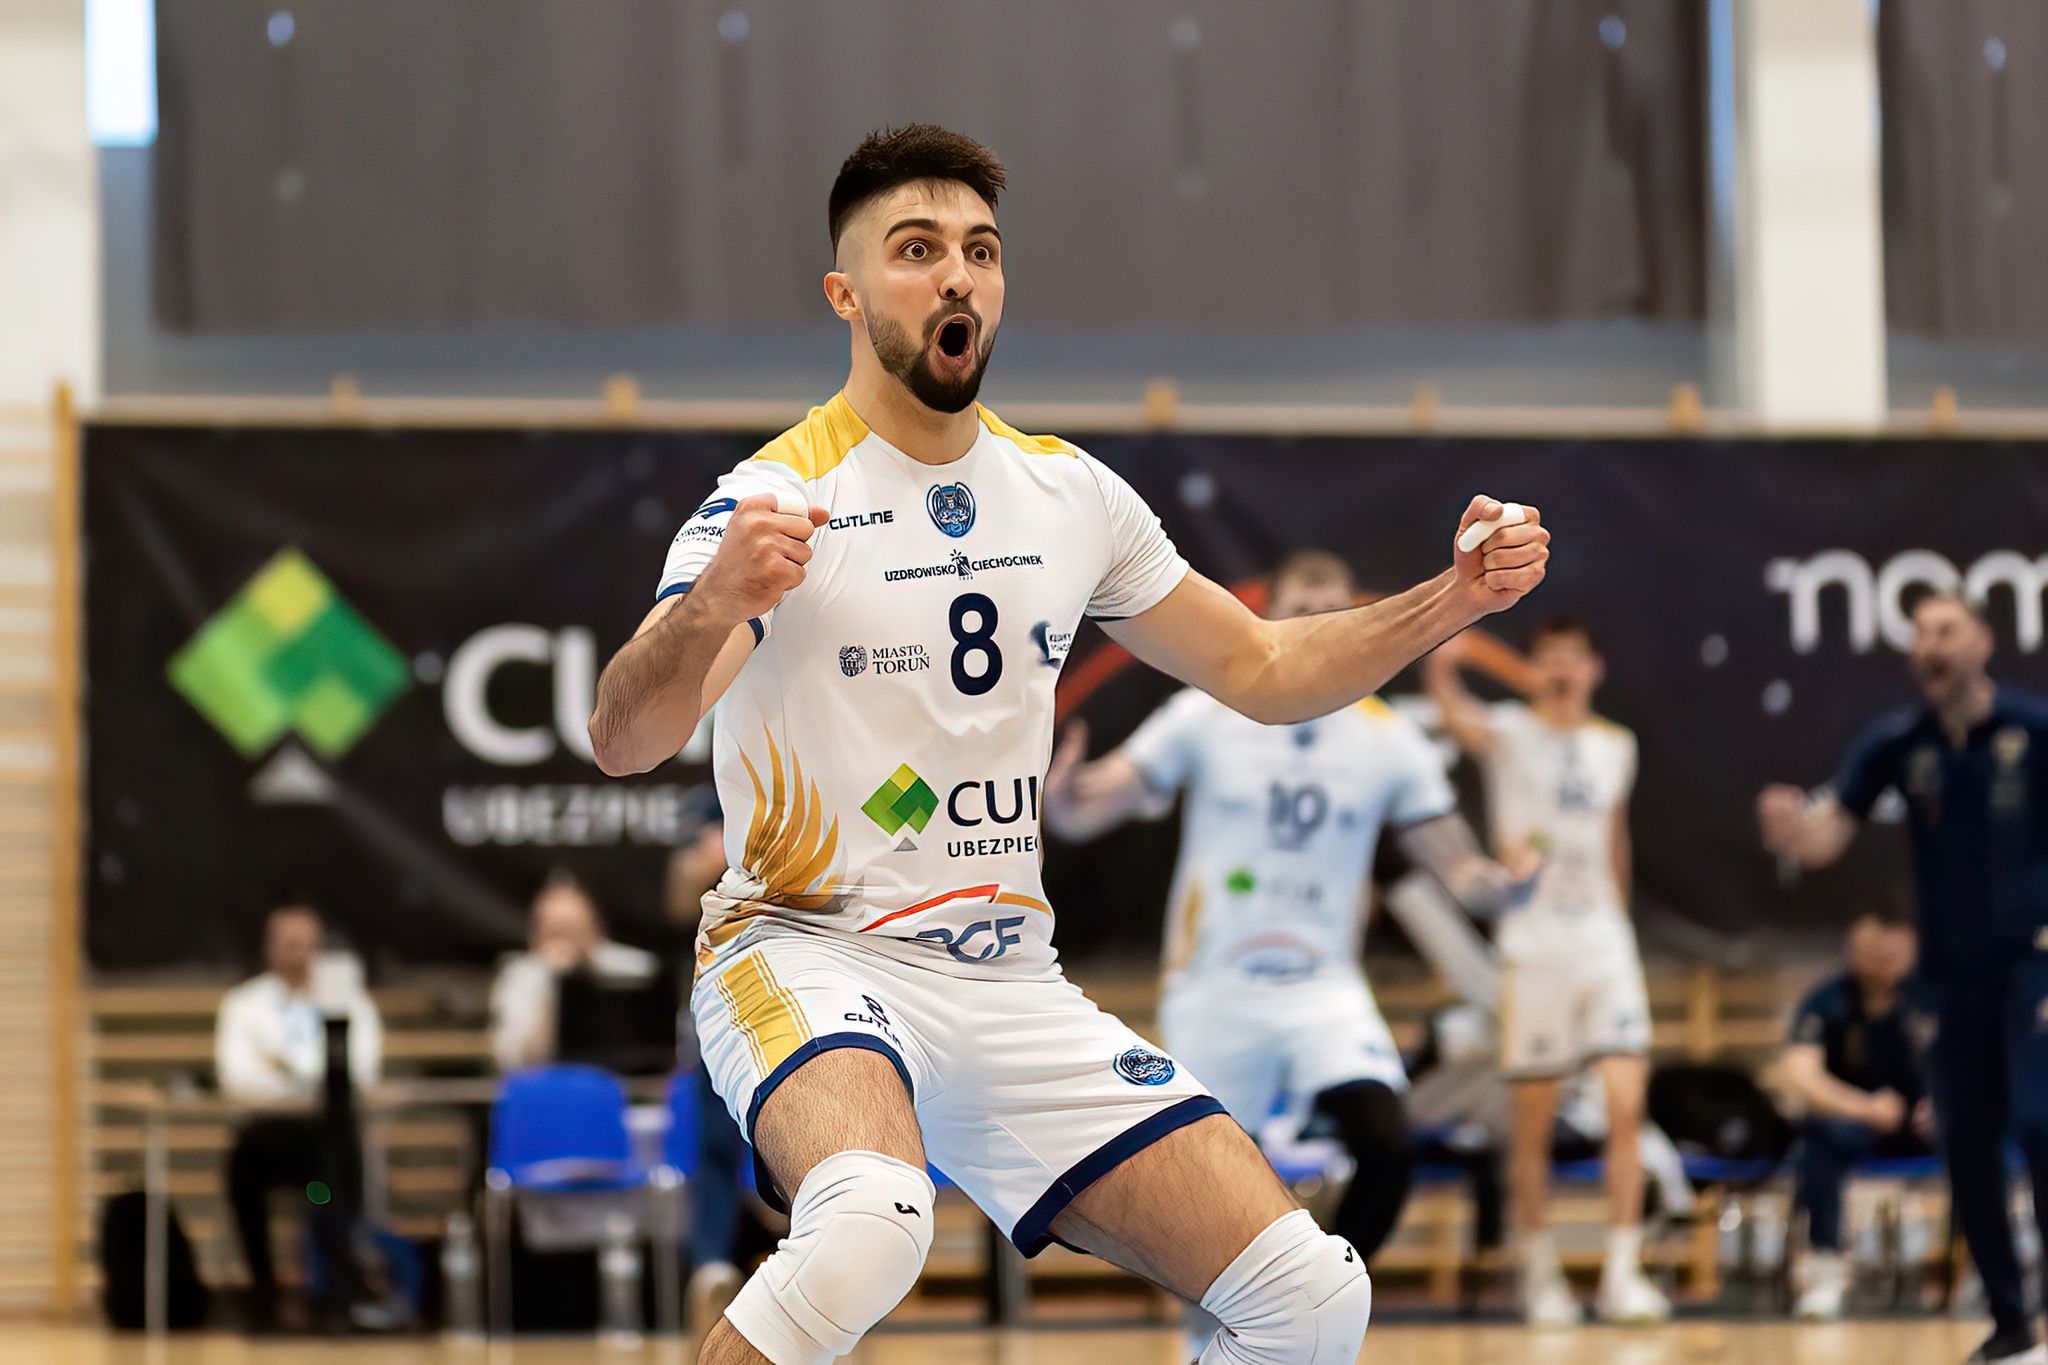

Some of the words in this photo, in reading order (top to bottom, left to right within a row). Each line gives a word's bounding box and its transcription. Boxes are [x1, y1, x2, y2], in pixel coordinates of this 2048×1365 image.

[829, 510, 894, 530] CUTLINE
[884, 564, 957, 582] UZDROWISKO
[971, 555, 1043, 572] CIECHOCINEK
[872, 644, 924, 659] MIASTO
[948, 592, 1003, 696] 8
[872, 652, 930, 674] TORUŃ
